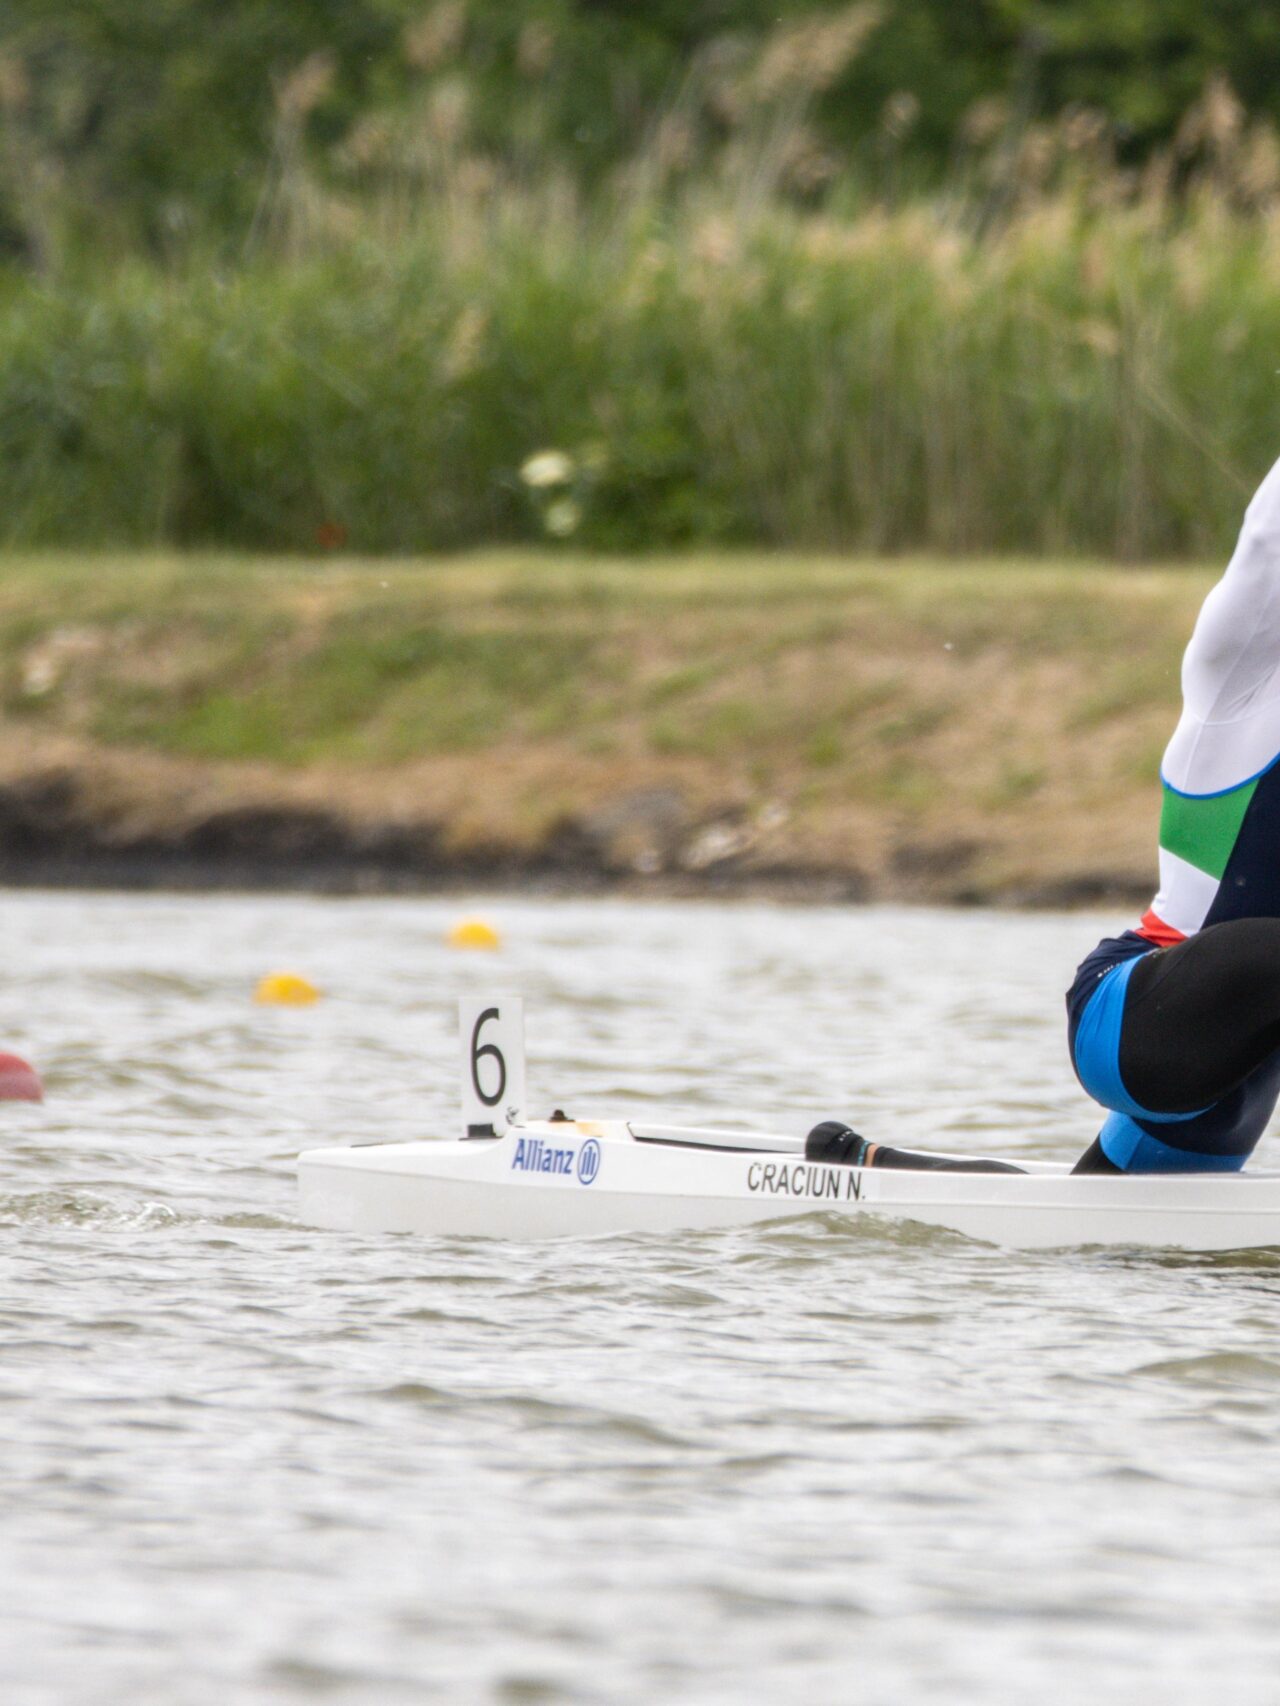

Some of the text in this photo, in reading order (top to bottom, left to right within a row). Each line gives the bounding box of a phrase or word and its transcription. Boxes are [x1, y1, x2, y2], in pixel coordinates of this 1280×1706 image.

[470, 1007, 507, 1107] 6
[511, 1138, 575, 1175] Allianz
[747, 1162, 866, 1201] CRACIUN N.
